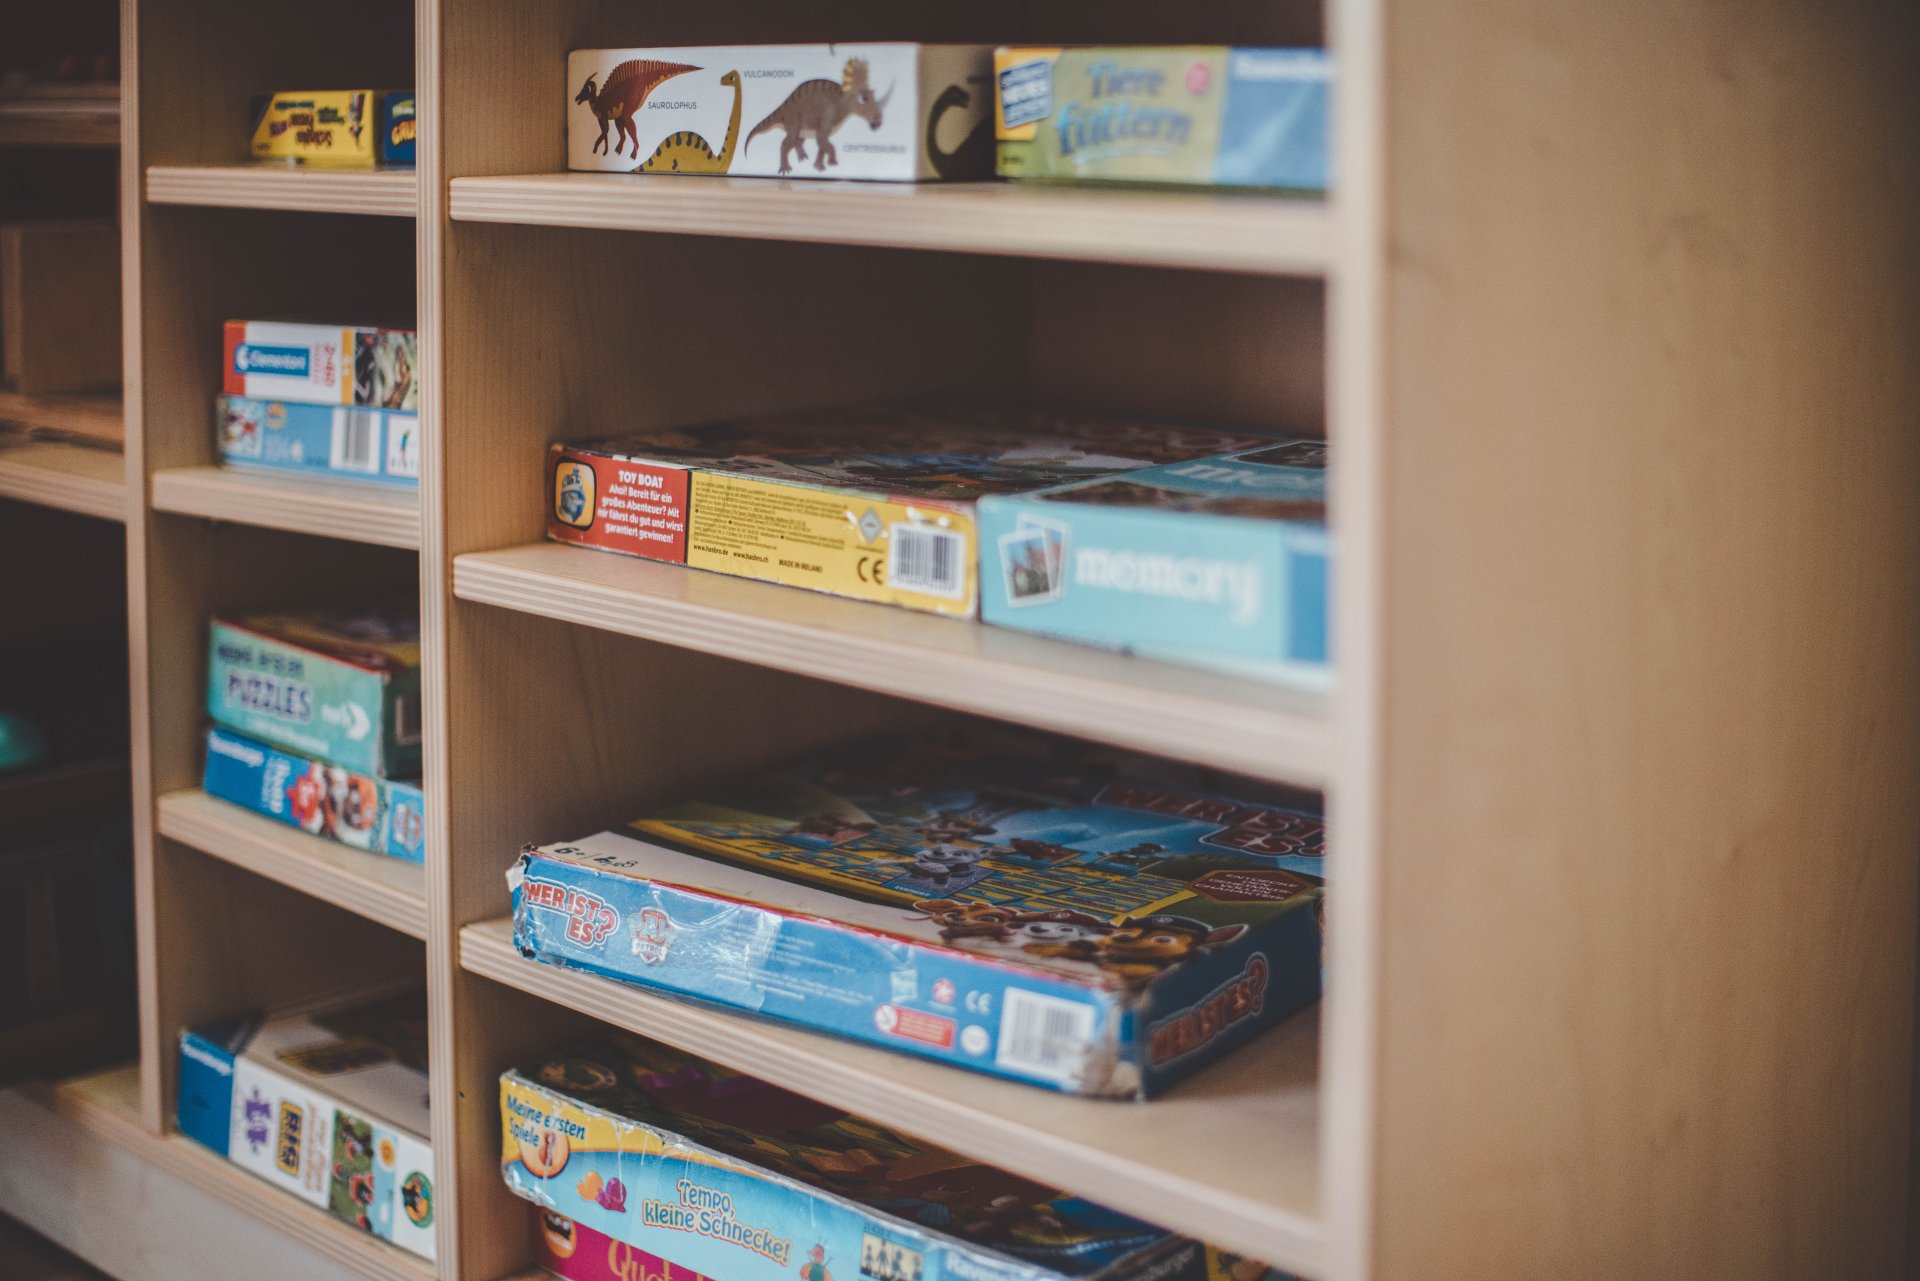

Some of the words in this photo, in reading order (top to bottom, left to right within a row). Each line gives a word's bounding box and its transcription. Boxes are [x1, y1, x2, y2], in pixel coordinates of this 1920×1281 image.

[743, 70, 794, 78] VULCANODON
[1086, 60, 1166, 98] Tiere
[647, 101, 697, 110] SAUROLOPHUS
[250, 350, 307, 371] Clementoni
[618, 470, 637, 483] TOY
[638, 473, 664, 489] BOAT
[609, 484, 628, 497] Ahoi!
[628, 488, 650, 502] Bereit
[650, 491, 661, 503] für
[661, 493, 673, 504] ein
[602, 496, 626, 508] großes
[626, 502, 667, 515] Abenteuer?
[667, 507, 680, 518] Mit
[597, 509, 608, 518] mir
[608, 511, 629, 523] fährst
[629, 514, 640, 525] du
[640, 517, 651, 528] gut
[651, 517, 665, 529] und
[666, 520, 684, 532] wirst
[604, 524, 642, 538] garantiert
[639, 529, 674, 544] gewinnen!
[693, 544, 729, 556] www.hasbro.de
[733, 551, 769, 563] www.hasbro.ch
[779, 559, 794, 569] MADE
[794, 561, 801, 569] IN
[800, 562, 823, 573] IRELAND
[1075, 548, 1263, 625] memory
[228, 672, 313, 719] PUZZLES
[525, 880, 567, 909] WER
[566, 891, 601, 921] IST
[568, 909, 617, 943] ES?
[507, 1094, 543, 1124] Meine
[543, 1115, 586, 1141] ersten
[509, 1117, 540, 1147] Spiele
[678, 1180, 736, 1219] Tempo,
[643, 1202, 695, 1229] kleine
[699, 1212, 791, 1263] Schnecke!
